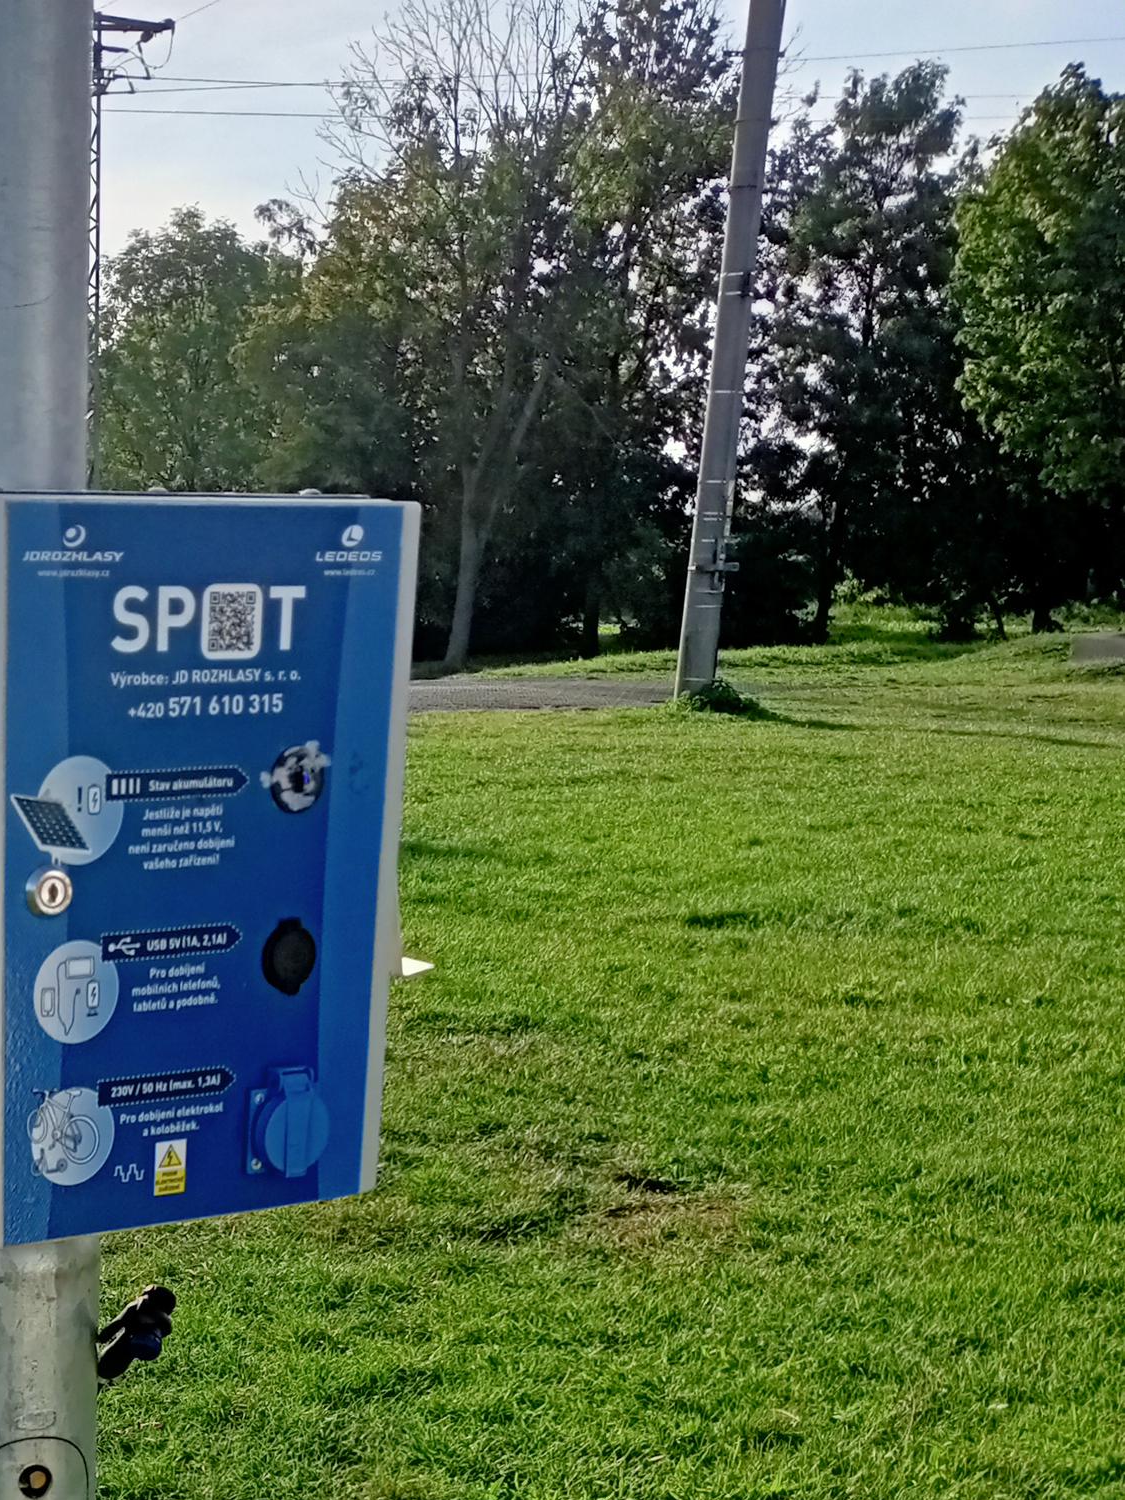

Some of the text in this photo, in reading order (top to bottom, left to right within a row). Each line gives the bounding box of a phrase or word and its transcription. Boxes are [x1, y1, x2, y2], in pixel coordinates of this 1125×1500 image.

[315, 551, 383, 562] LEDEOS
[110, 668, 301, 689] Výrobce: JD ROZHLASY s. r. o.
[128, 693, 284, 718] +420 571 610 315
[148, 775, 234, 792] Stav akumulátoru
[142, 806, 181, 821] Jestliže
[181, 805, 191, 820] je
[141, 820, 224, 837] menší než 11,5 V,
[128, 841, 150, 855] není
[151, 839, 195, 853] zaručeno
[142, 857, 177, 870] vašeho
[146, 938, 167, 952] USB
[202, 932, 227, 946] 2,1A)
[149, 967, 167, 979] Pro
[131, 981, 179, 997] mobilních
[133, 997, 167, 1013] tabletů
[168, 1000, 175, 1009] a
[110, 1073, 222, 1098] 230V / 50 Hz (max. 1,3A)
[119, 1112, 137, 1124] Pro
[176, 1101, 224, 1118] elektrokol
[142, 1127, 149, 1137] a
